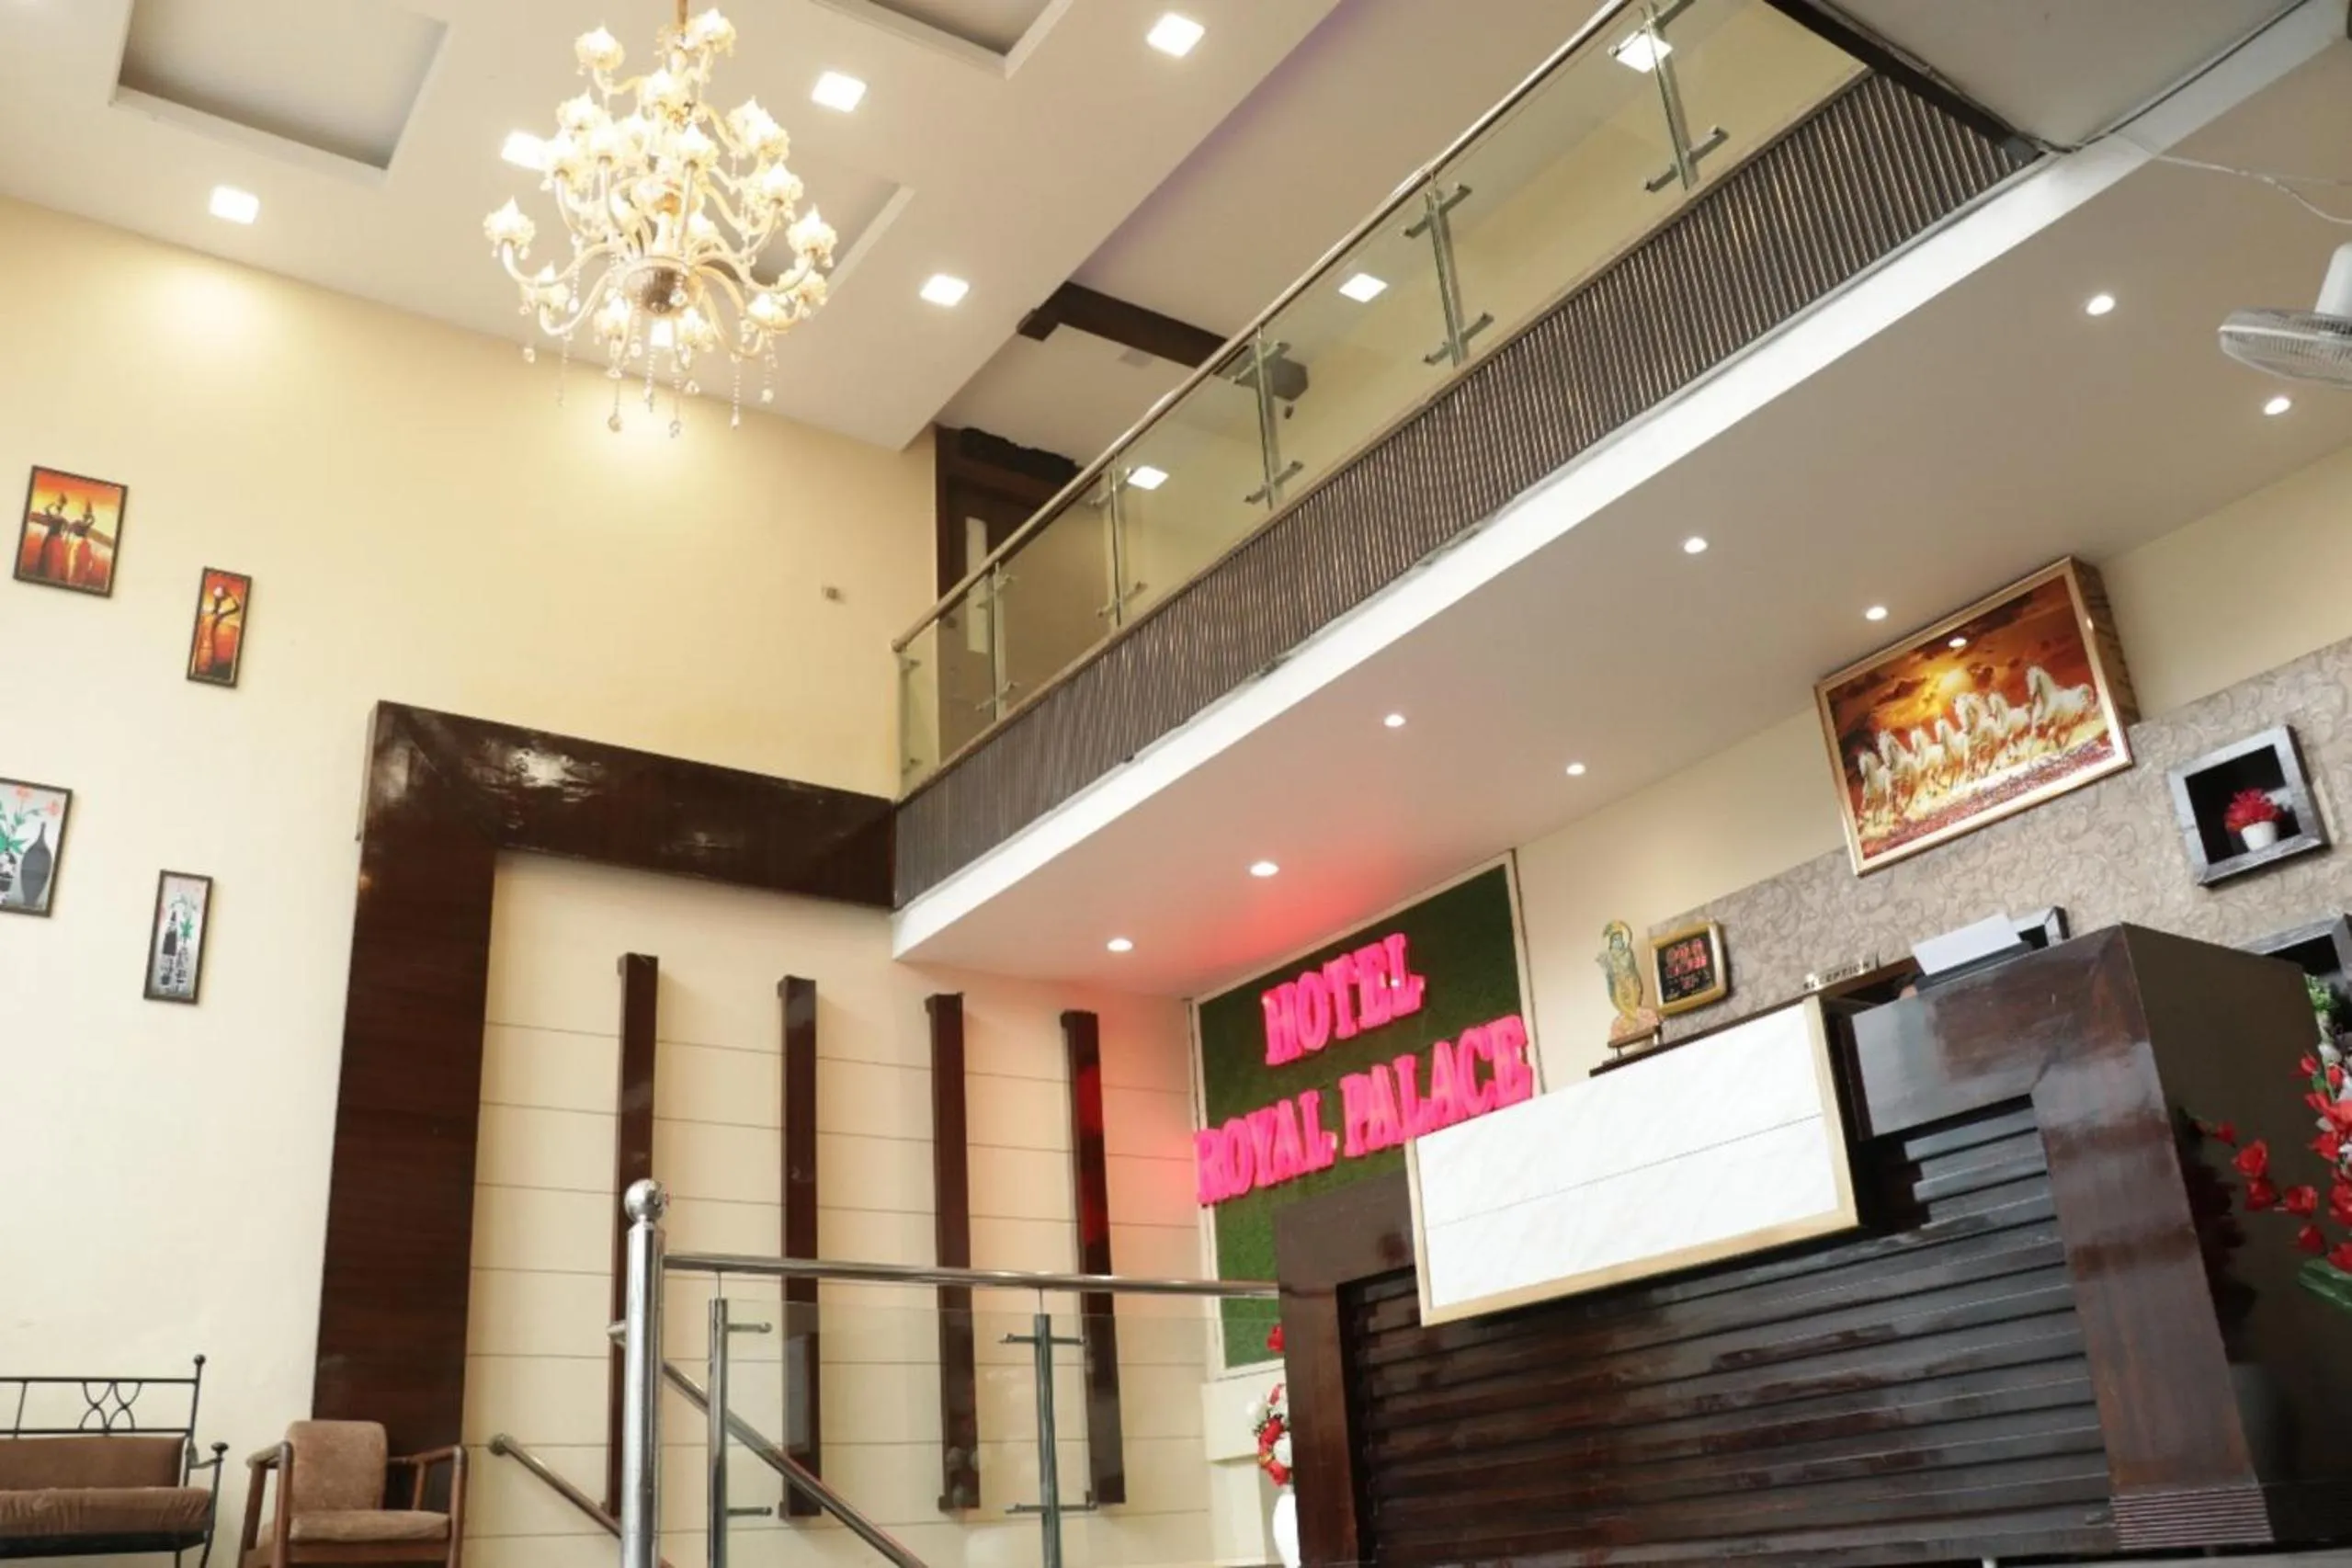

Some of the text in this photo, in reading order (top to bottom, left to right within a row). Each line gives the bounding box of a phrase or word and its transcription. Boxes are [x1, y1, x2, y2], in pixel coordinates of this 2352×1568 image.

[1261, 932, 1426, 1066] HOTEL
[1802, 960, 1870, 990] REEPTION
[1195, 1015, 1533, 1207] ROYAL PALACE
